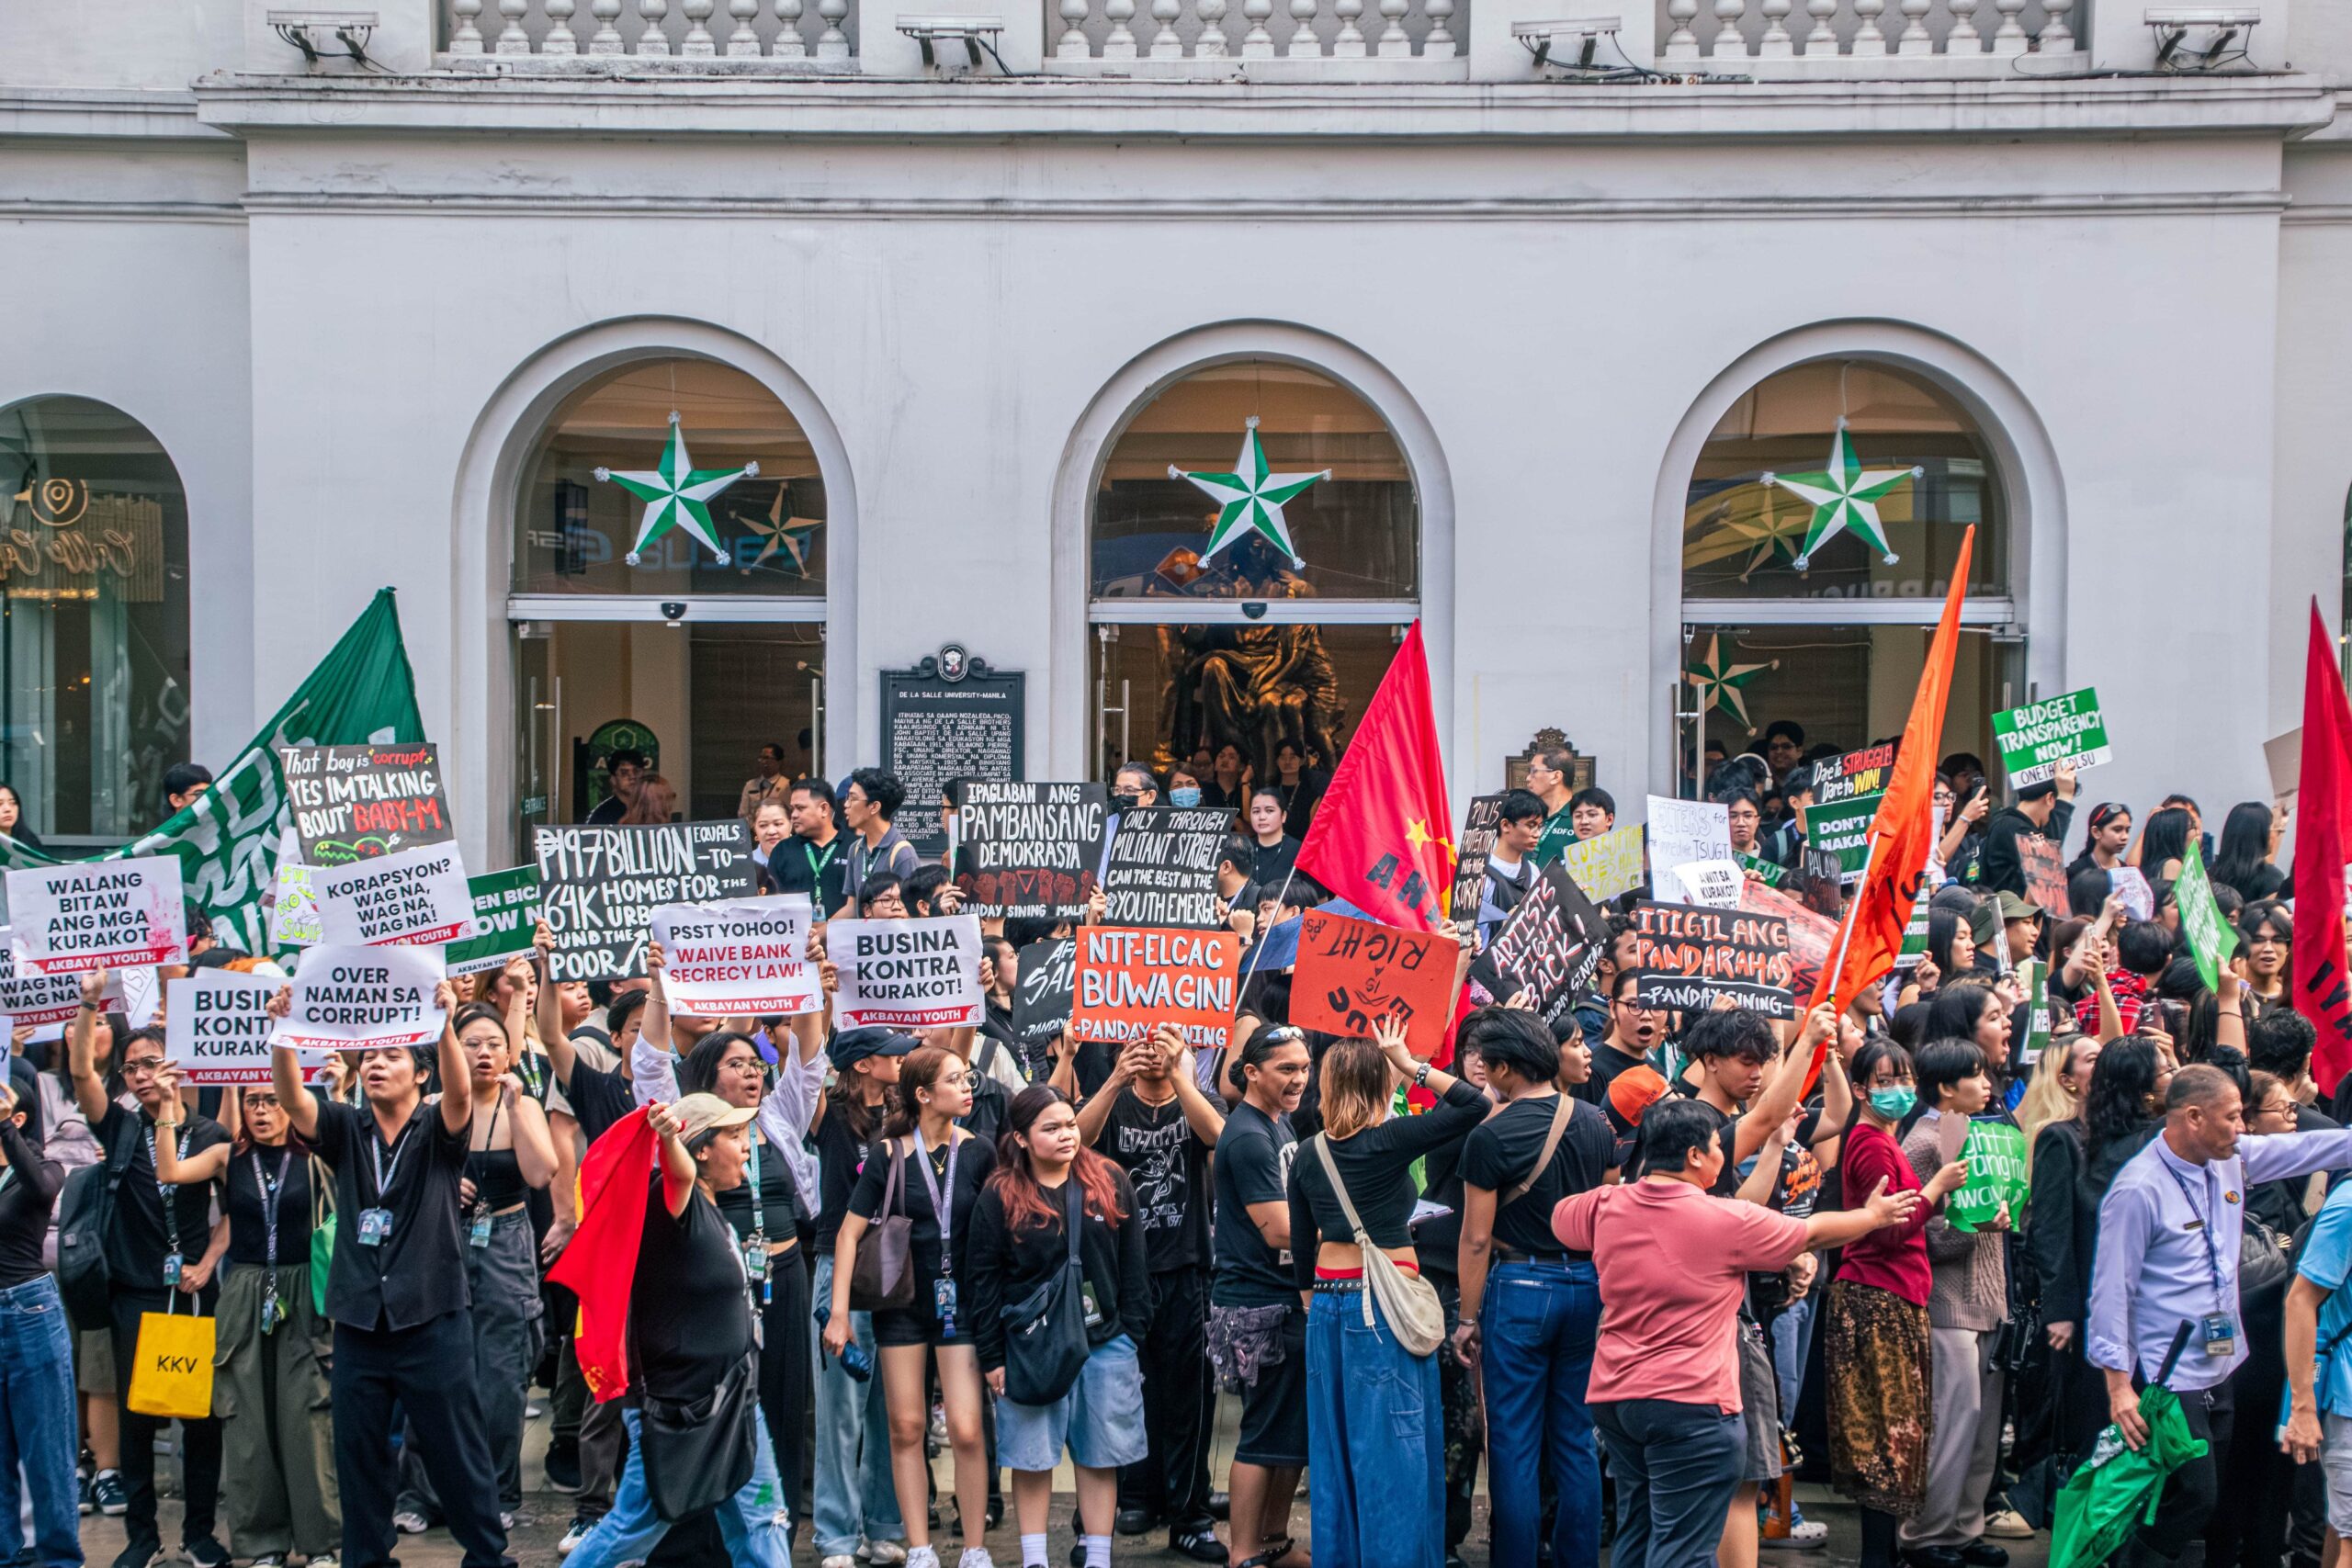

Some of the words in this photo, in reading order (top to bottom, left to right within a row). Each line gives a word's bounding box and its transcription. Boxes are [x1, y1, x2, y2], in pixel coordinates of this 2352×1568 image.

[2013, 694, 2077, 729] BUDGET
[1996, 709, 2100, 753] TRANSPARENCY
[2034, 734, 2082, 762] NOW!
[280, 748, 321, 774] That
[326, 749, 353, 773] boy
[356, 754, 369, 767] is
[373, 748, 426, 769] corrupt
[1813, 761, 1834, 786] Dare
[1834, 757, 1843, 774] to
[1843, 744, 1894, 776] STRUGGLE!
[288, 778, 322, 807] YES
[967, 784, 1036, 804] IPAGLABAN
[1048, 785, 1080, 804] ANG
[1822, 782, 1843, 803] Dare
[1844, 777, 1854, 795] to
[1854, 768, 1881, 795] WIN!
[353, 797, 442, 832] BABY-M
[961, 803, 1102, 842] PAMBANSANG
[1124, 811, 1158, 829] ONLY
[1169, 812, 1228, 830] THROUGH
[1471, 802, 1501, 826] PULIS
[1819, 816, 1866, 835] DON'T
[1552, 827, 1574, 836] SDFO
[604, 827, 697, 877] BILLION
[695, 825, 741, 843] EQUALS
[979, 842, 1080, 869] DEMOKRASYA
[1110, 832, 1171, 863] MILITANT
[326, 858, 451, 899] KORAPSYON?
[1461, 860, 1473, 874] NG
[1720, 869, 1731, 882] SA
[47, 873, 142, 896] WALANG
[1108, 870, 1131, 885] CAN
[1134, 869, 1153, 885] THE
[1155, 871, 1180, 887] BEST
[1181, 874, 1191, 887] IN
[1193, 874, 1213, 889] THE
[59, 892, 129, 913] BITAW
[354, 888, 396, 908] WAG
[401, 882, 431, 896] NA,
[544, 884, 604, 932] 64K
[602, 877, 679, 906] HOMES
[681, 874, 721, 900] FOR
[721, 878, 748, 889] THE
[1701, 886, 1738, 899] KURAKOT!
[276, 894, 300, 916] NO
[357, 904, 401, 922] WAG
[403, 897, 434, 914] NA,
[1006, 905, 1046, 918] SINING
[1117, 890, 1164, 921] YOUTH
[1166, 892, 1217, 924] EMERGE
[48, 915, 95, 933] ANG
[99, 909, 149, 928] MGA
[360, 919, 402, 938] WAG
[406, 910, 437, 929] NA!
[670, 924, 713, 940] PSST
[718, 919, 795, 938] YOHOO!
[1490, 877, 1555, 979] ARTISTS
[1638, 907, 1730, 942] ITIGIL
[1732, 919, 1788, 948] ANG
[49, 927, 150, 951] KURAKOT
[414, 928, 452, 944] YOUTH
[603, 930, 633, 943] THE
[856, 930, 959, 957] BUSINA
[1317, 921, 1431, 971] RIGHT
[1511, 905, 1562, 987] FIGHT
[676, 945, 741, 963] WAIVE
[745, 943, 792, 959] BANK
[1088, 931, 1223, 968] NTF-ELCAC
[47, 956, 110, 972] AKBAYAN
[458, 960, 492, 974] AKBAYAN
[548, 949, 617, 980] POOR
[670, 964, 752, 984] SECRECY
[757, 963, 802, 979] LAW!
[856, 955, 962, 981] KONTRA
[1374, 965, 1385, 977] A
[1522, 913, 1589, 1013] BACK!
[1637, 939, 1793, 990] PANDARAHAS
[1, 977, 45, 995] WAG
[332, 967, 390, 984] OVER
[1365, 977, 1380, 993] IS
[3, 992, 49, 1009] WAG
[305, 987, 389, 1003] NAMAN
[393, 987, 422, 1003] SA
[858, 979, 962, 999] KURAKOT!
[1082, 968, 1232, 1012] BUWAGIN!
[306, 1007, 421, 1024] CORRUPT!
[694, 998, 752, 1011] AKBAYAN
[752, 997, 793, 1010] YOUTH
[861, 1010, 922, 1023] AKBAYAN
[922, 1009, 961, 1021] YOUTH
[300, 1037, 366, 1047] AKBAYAN
[369, 1034, 412, 1045] YOUTH
[196, 1070, 258, 1080] AKBAYAN
[157, 1355, 198, 1374] KKV
